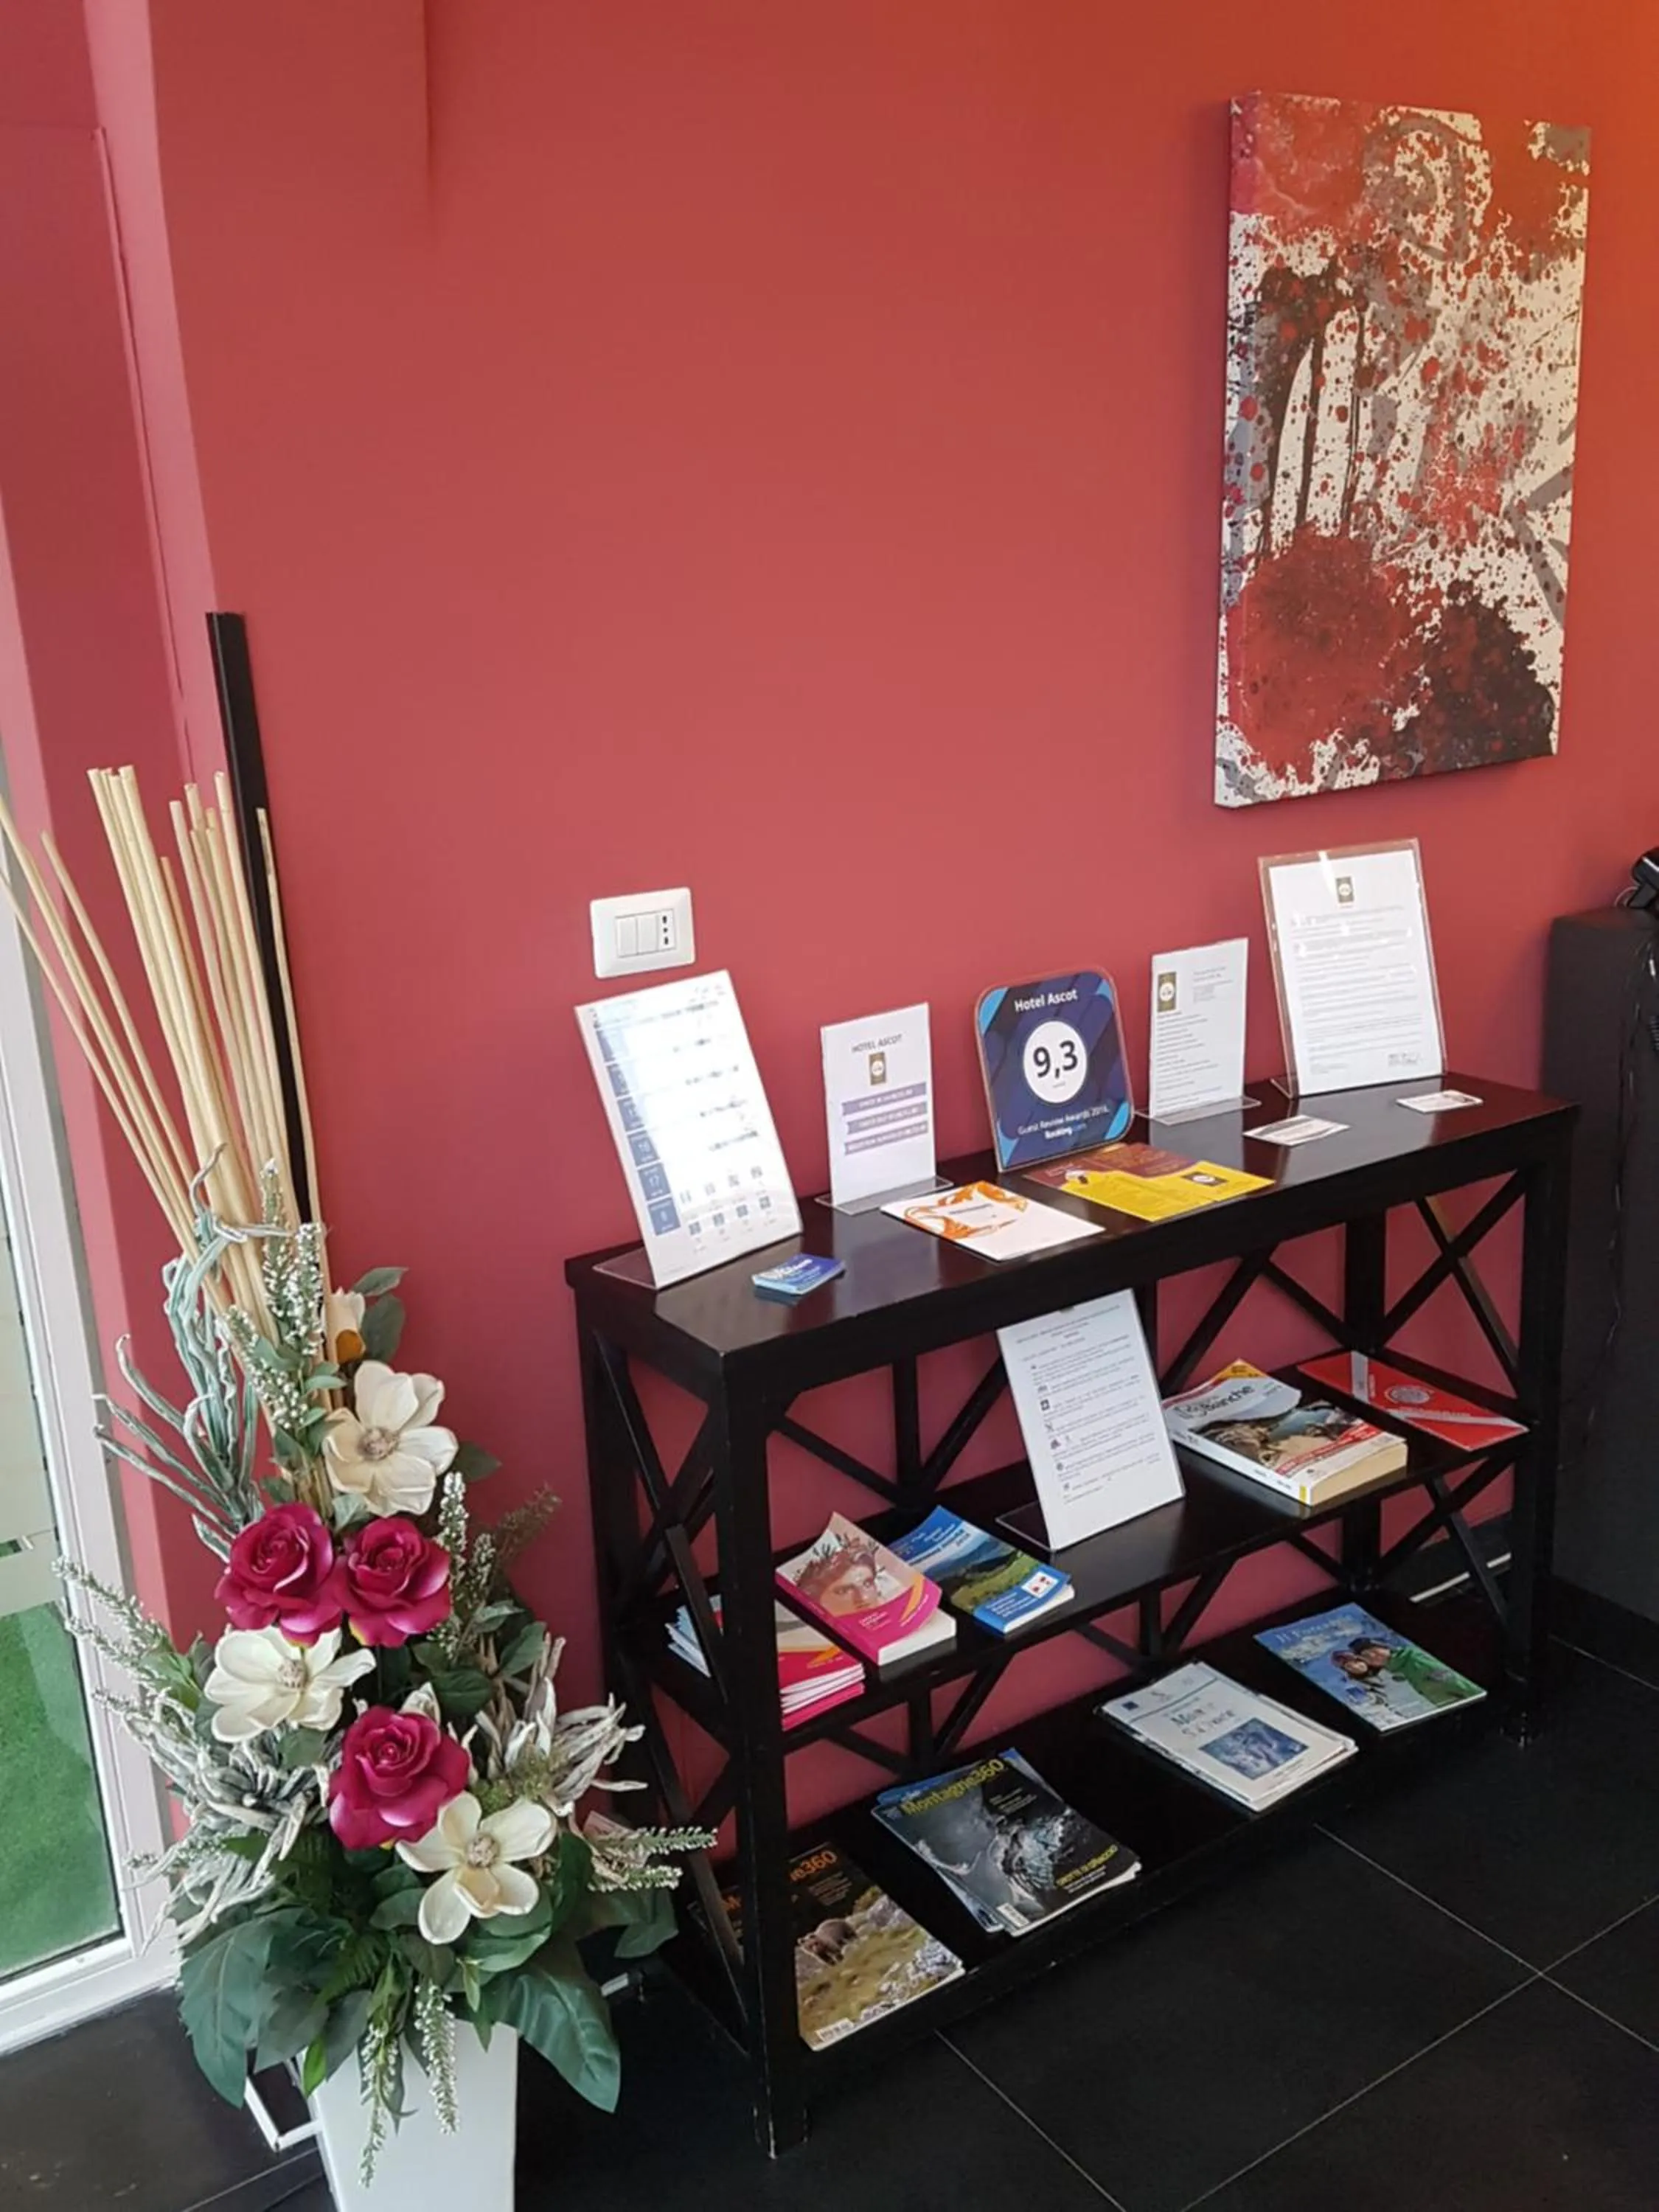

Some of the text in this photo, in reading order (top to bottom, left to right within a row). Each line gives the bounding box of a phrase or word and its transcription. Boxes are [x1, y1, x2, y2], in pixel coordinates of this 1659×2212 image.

[1014, 989, 1078, 1012] Hotel Ascot
[852, 1034, 902, 1053] HOTEL ASCOT
[1033, 1040, 1078, 1079] 9,3
[1017, 1123, 1039, 1135] Guest
[1040, 1117, 1064, 1129] Review
